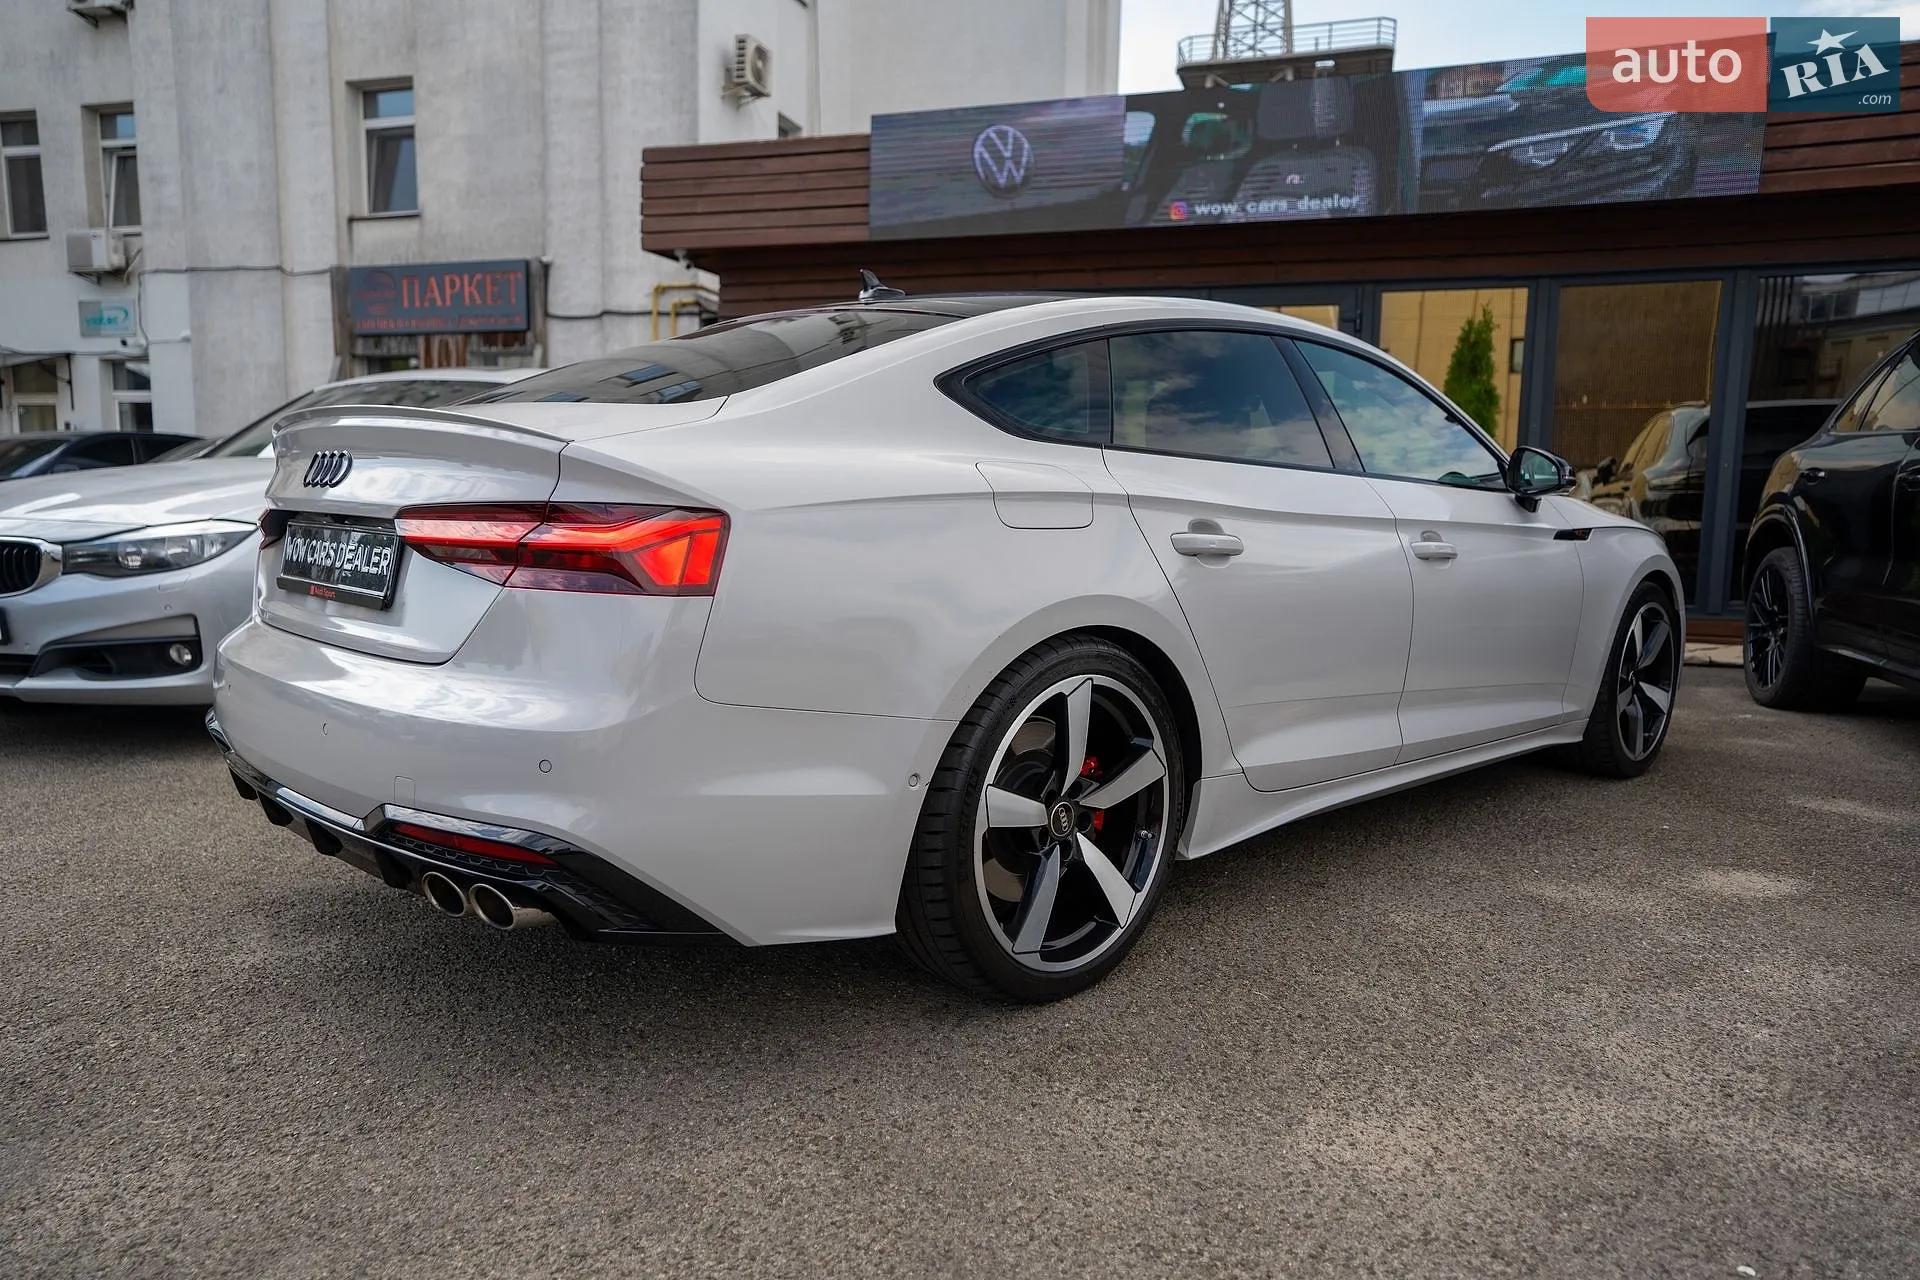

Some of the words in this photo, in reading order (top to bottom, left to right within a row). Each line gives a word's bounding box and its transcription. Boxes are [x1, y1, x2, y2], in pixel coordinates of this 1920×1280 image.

[401, 271, 523, 309] ПАРКЕТ
[285, 536, 310, 562] WOW
[307, 539, 338, 567] CARS
[335, 542, 392, 576] DEALER
